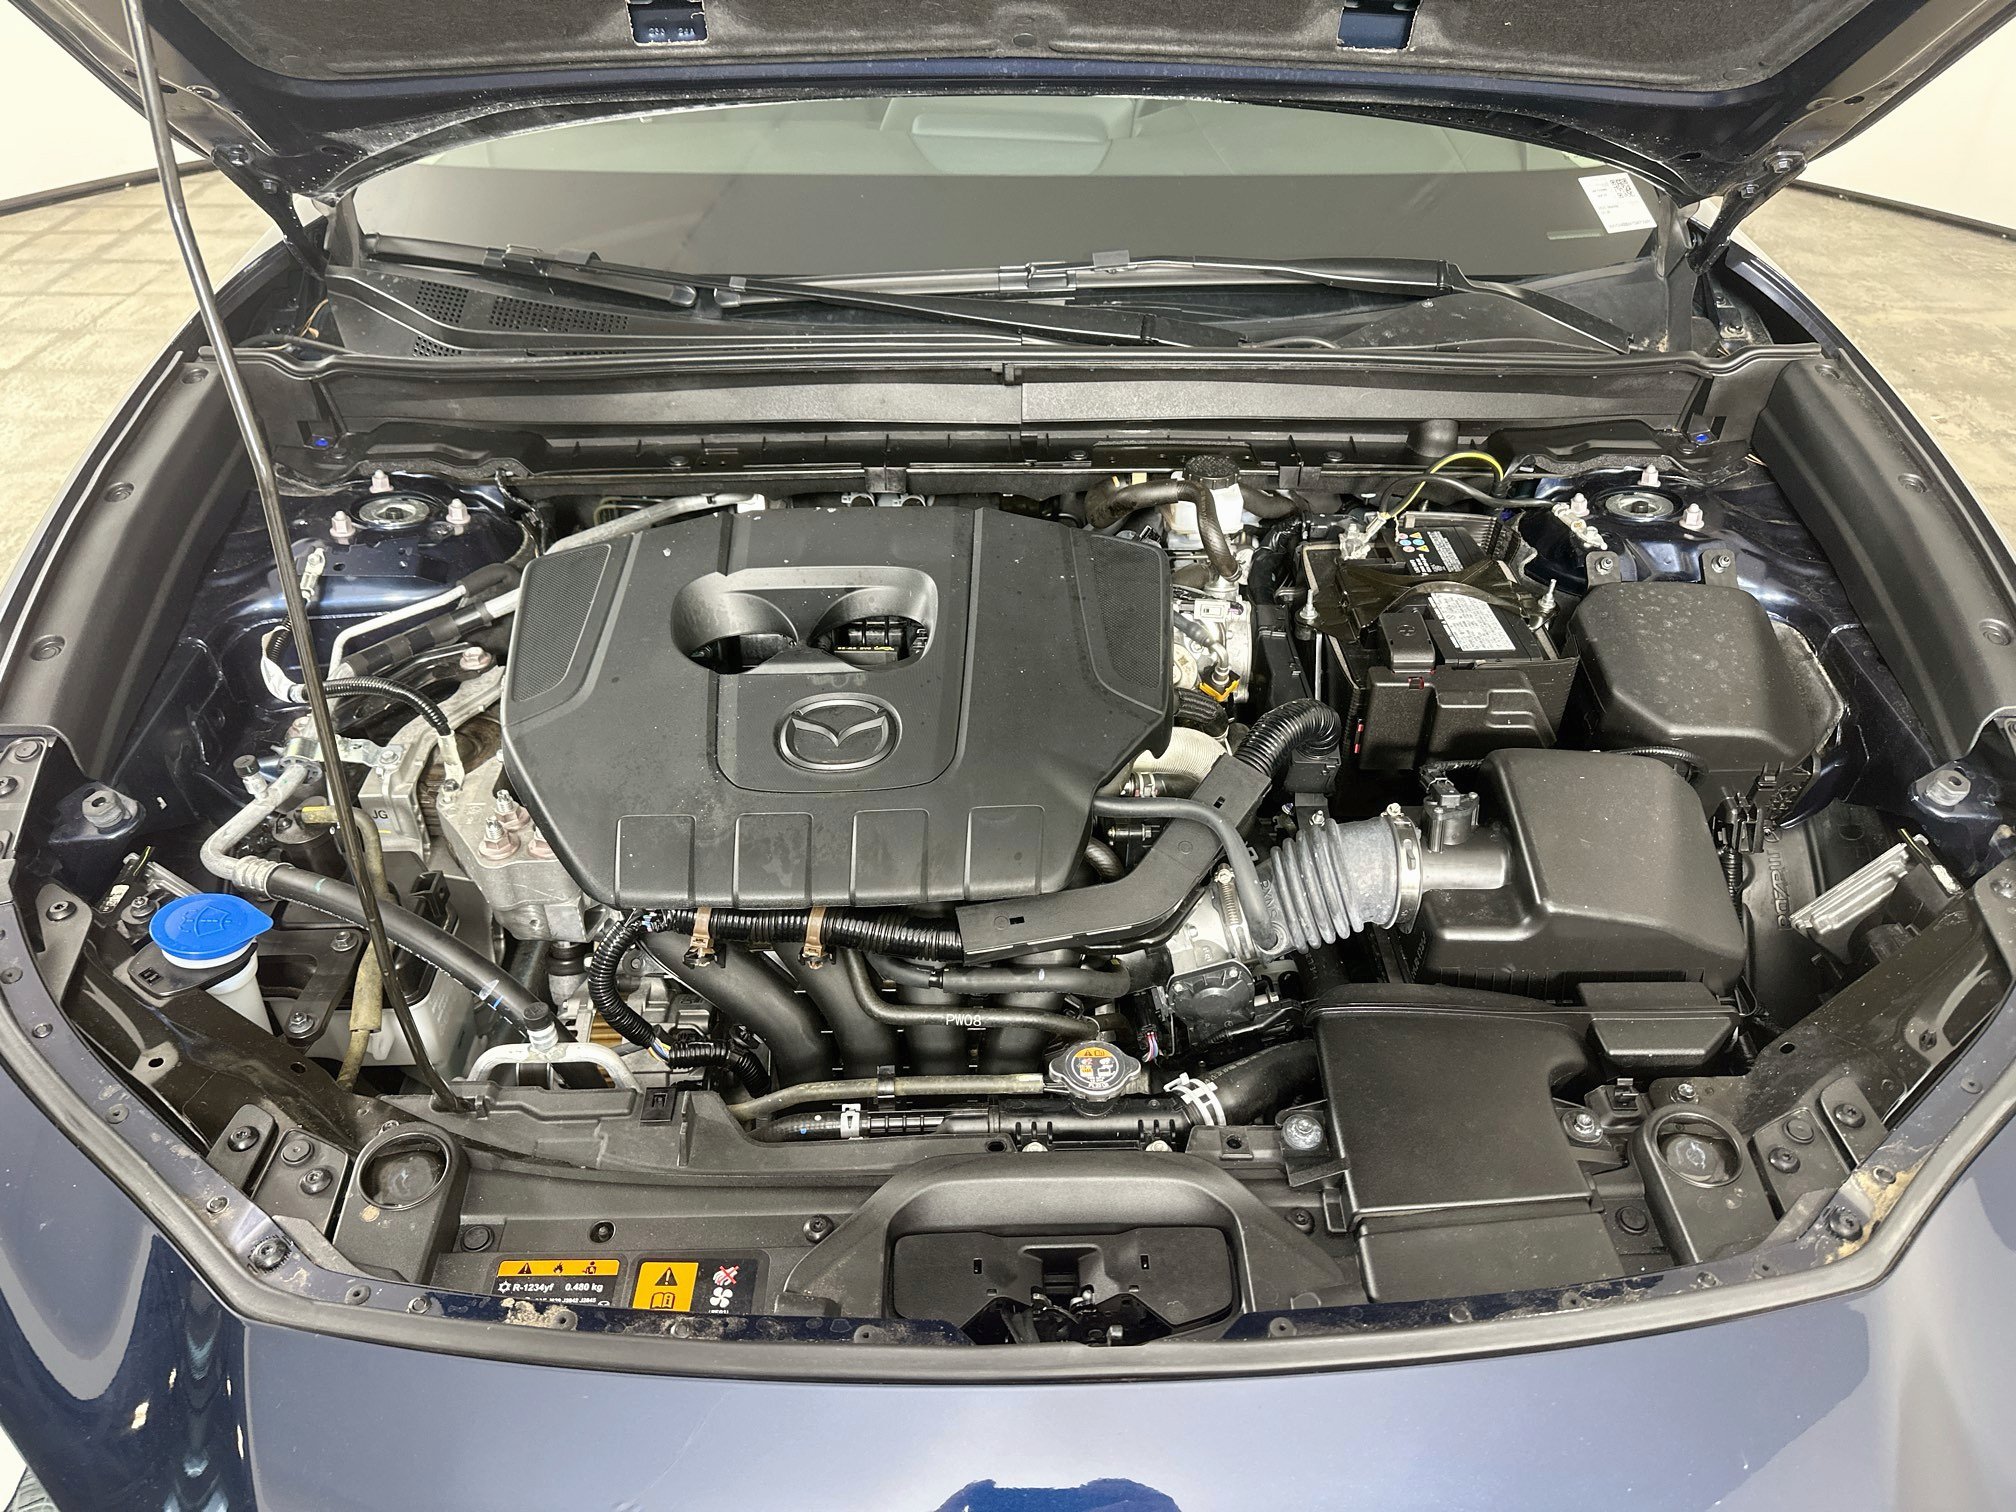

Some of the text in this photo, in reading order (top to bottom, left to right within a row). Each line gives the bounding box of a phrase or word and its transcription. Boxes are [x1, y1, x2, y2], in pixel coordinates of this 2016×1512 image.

[372, 809, 389, 819] JG
[512, 1282, 604, 1294] R-1234yf 0.480 kg
